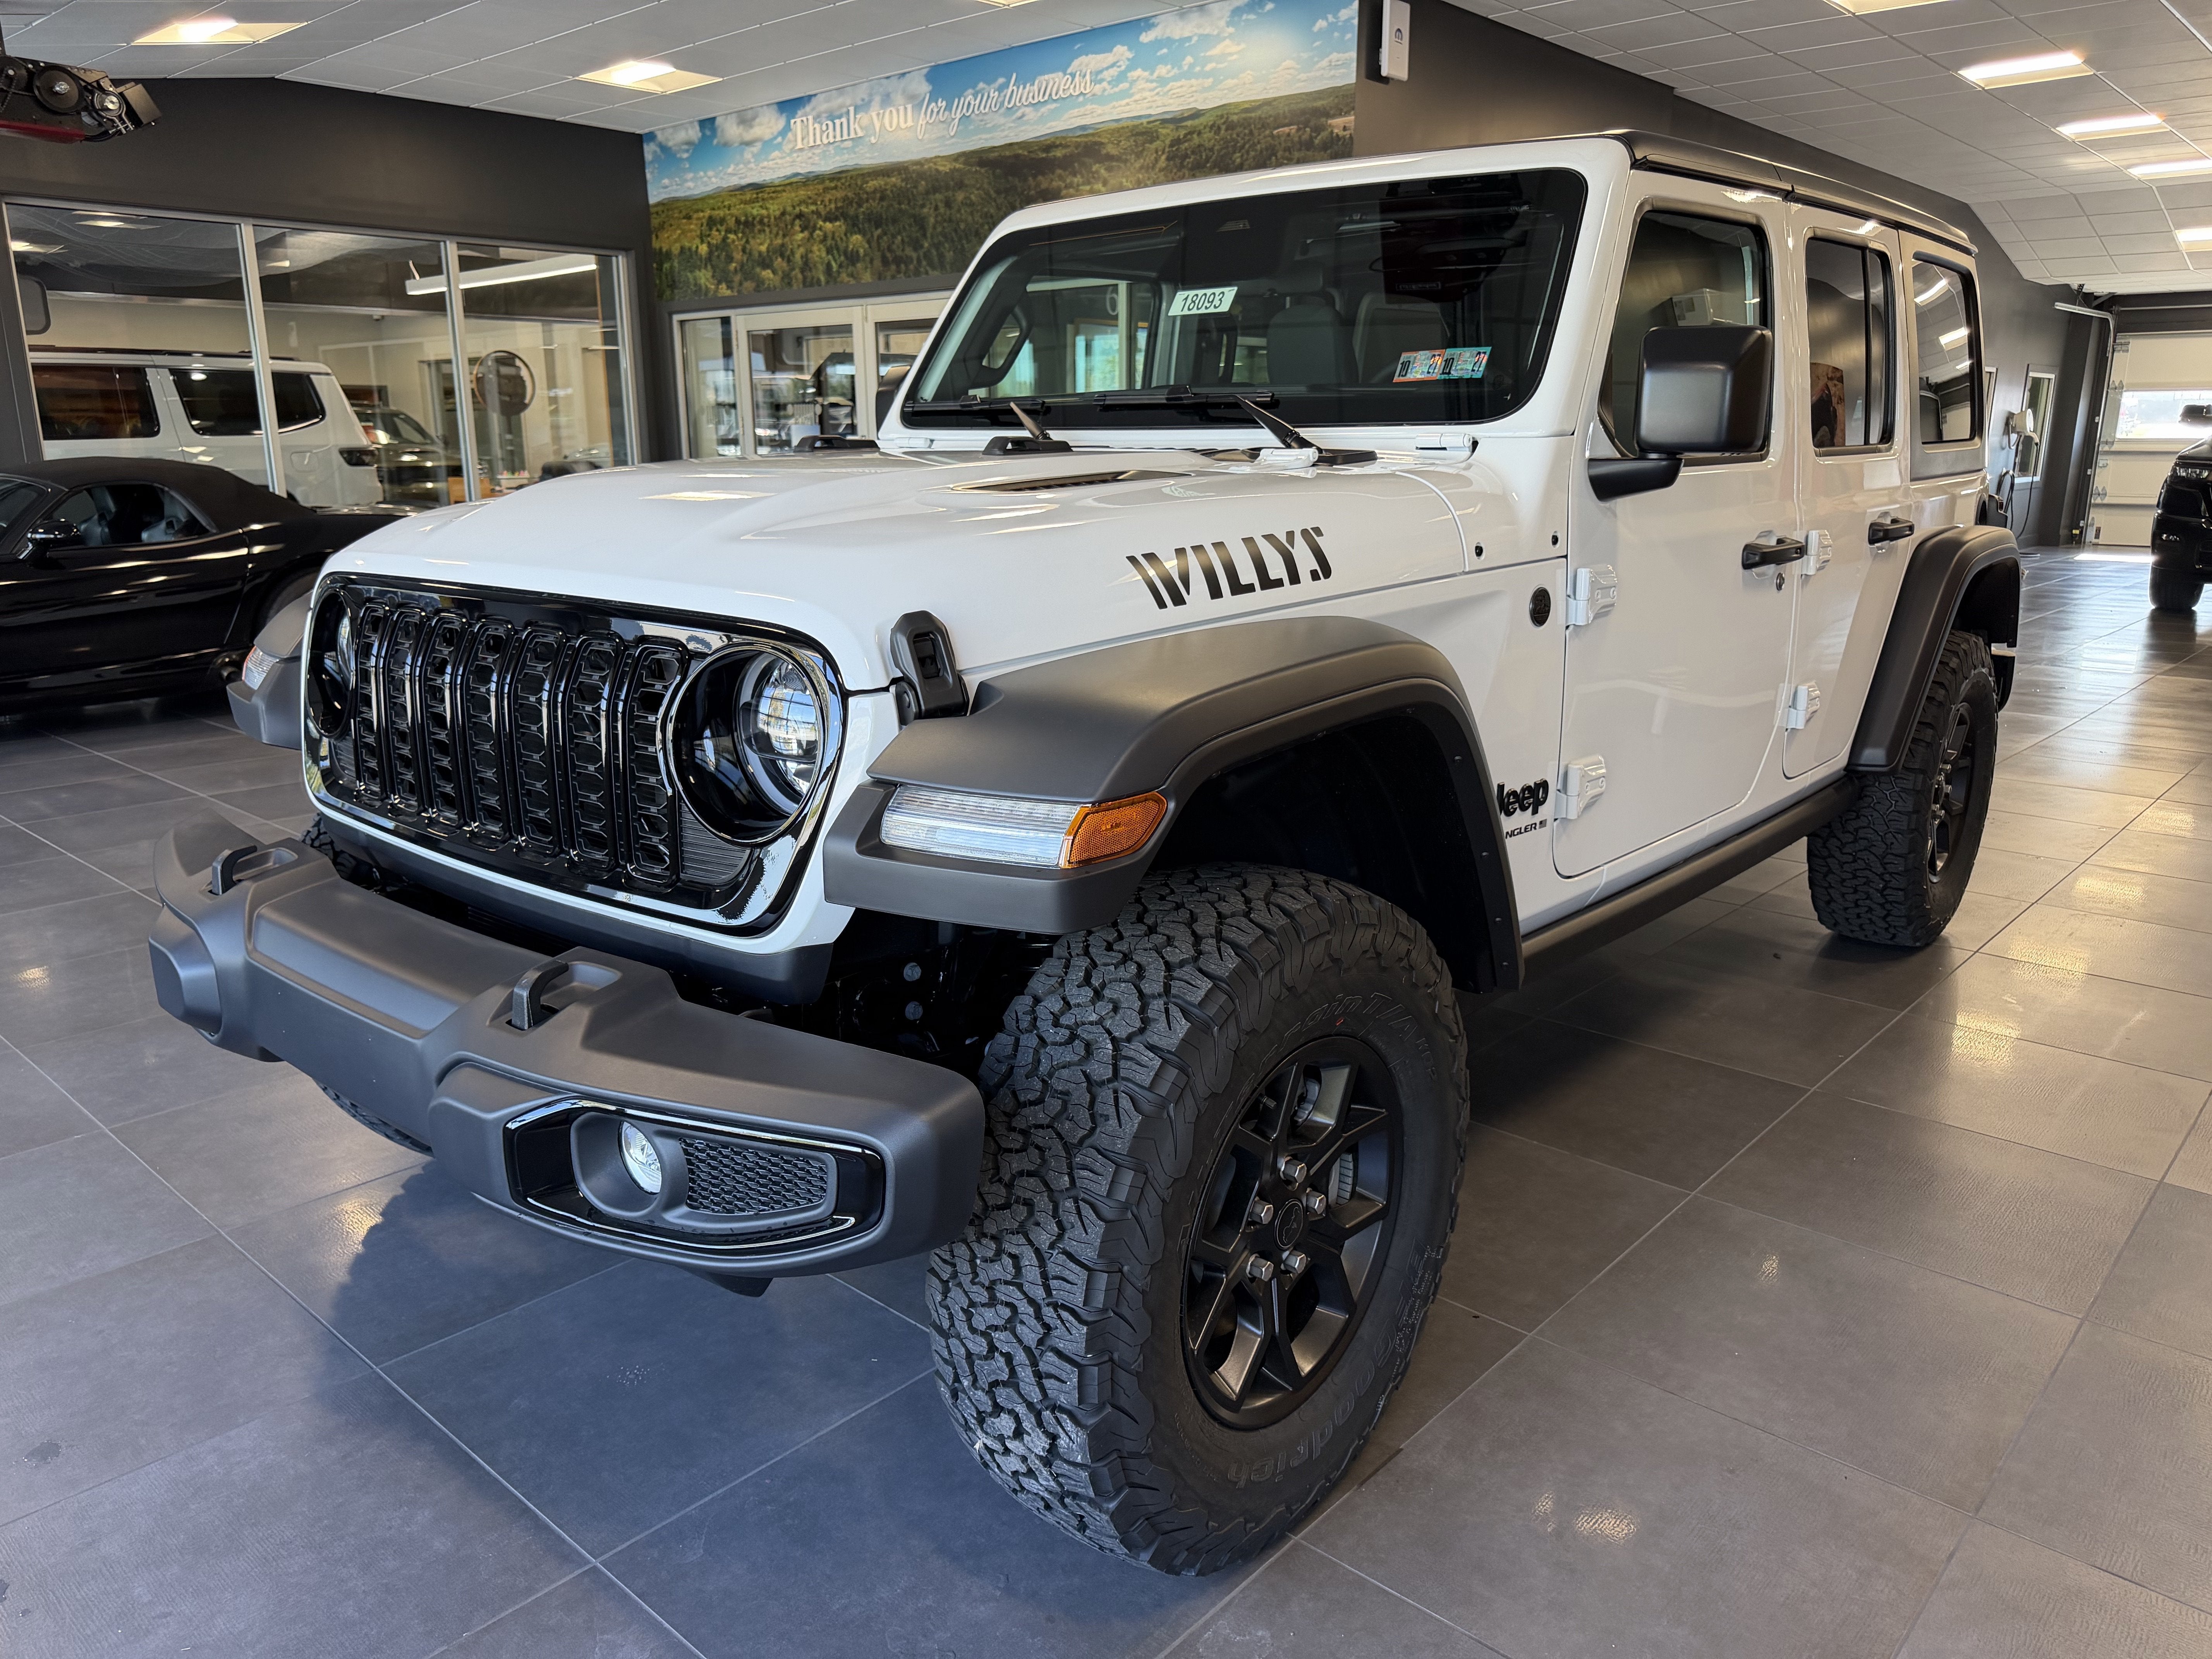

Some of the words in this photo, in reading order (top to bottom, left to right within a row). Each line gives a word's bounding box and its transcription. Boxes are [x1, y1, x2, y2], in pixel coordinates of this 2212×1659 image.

[790, 106, 864, 150] Thank
[870, 103, 915, 143] you
[917, 92, 948, 140] for
[948, 90, 1001, 137] your
[1004, 72, 1096, 110] business
[1180, 291, 1225, 312] 18093
[1398, 360, 1411, 378] 10
[1440, 357, 1455, 375] 10
[1470, 351, 1487, 373] 27
[1126, 527, 1332, 610] WILLYS
[1505, 822, 1537, 840] NGLER
